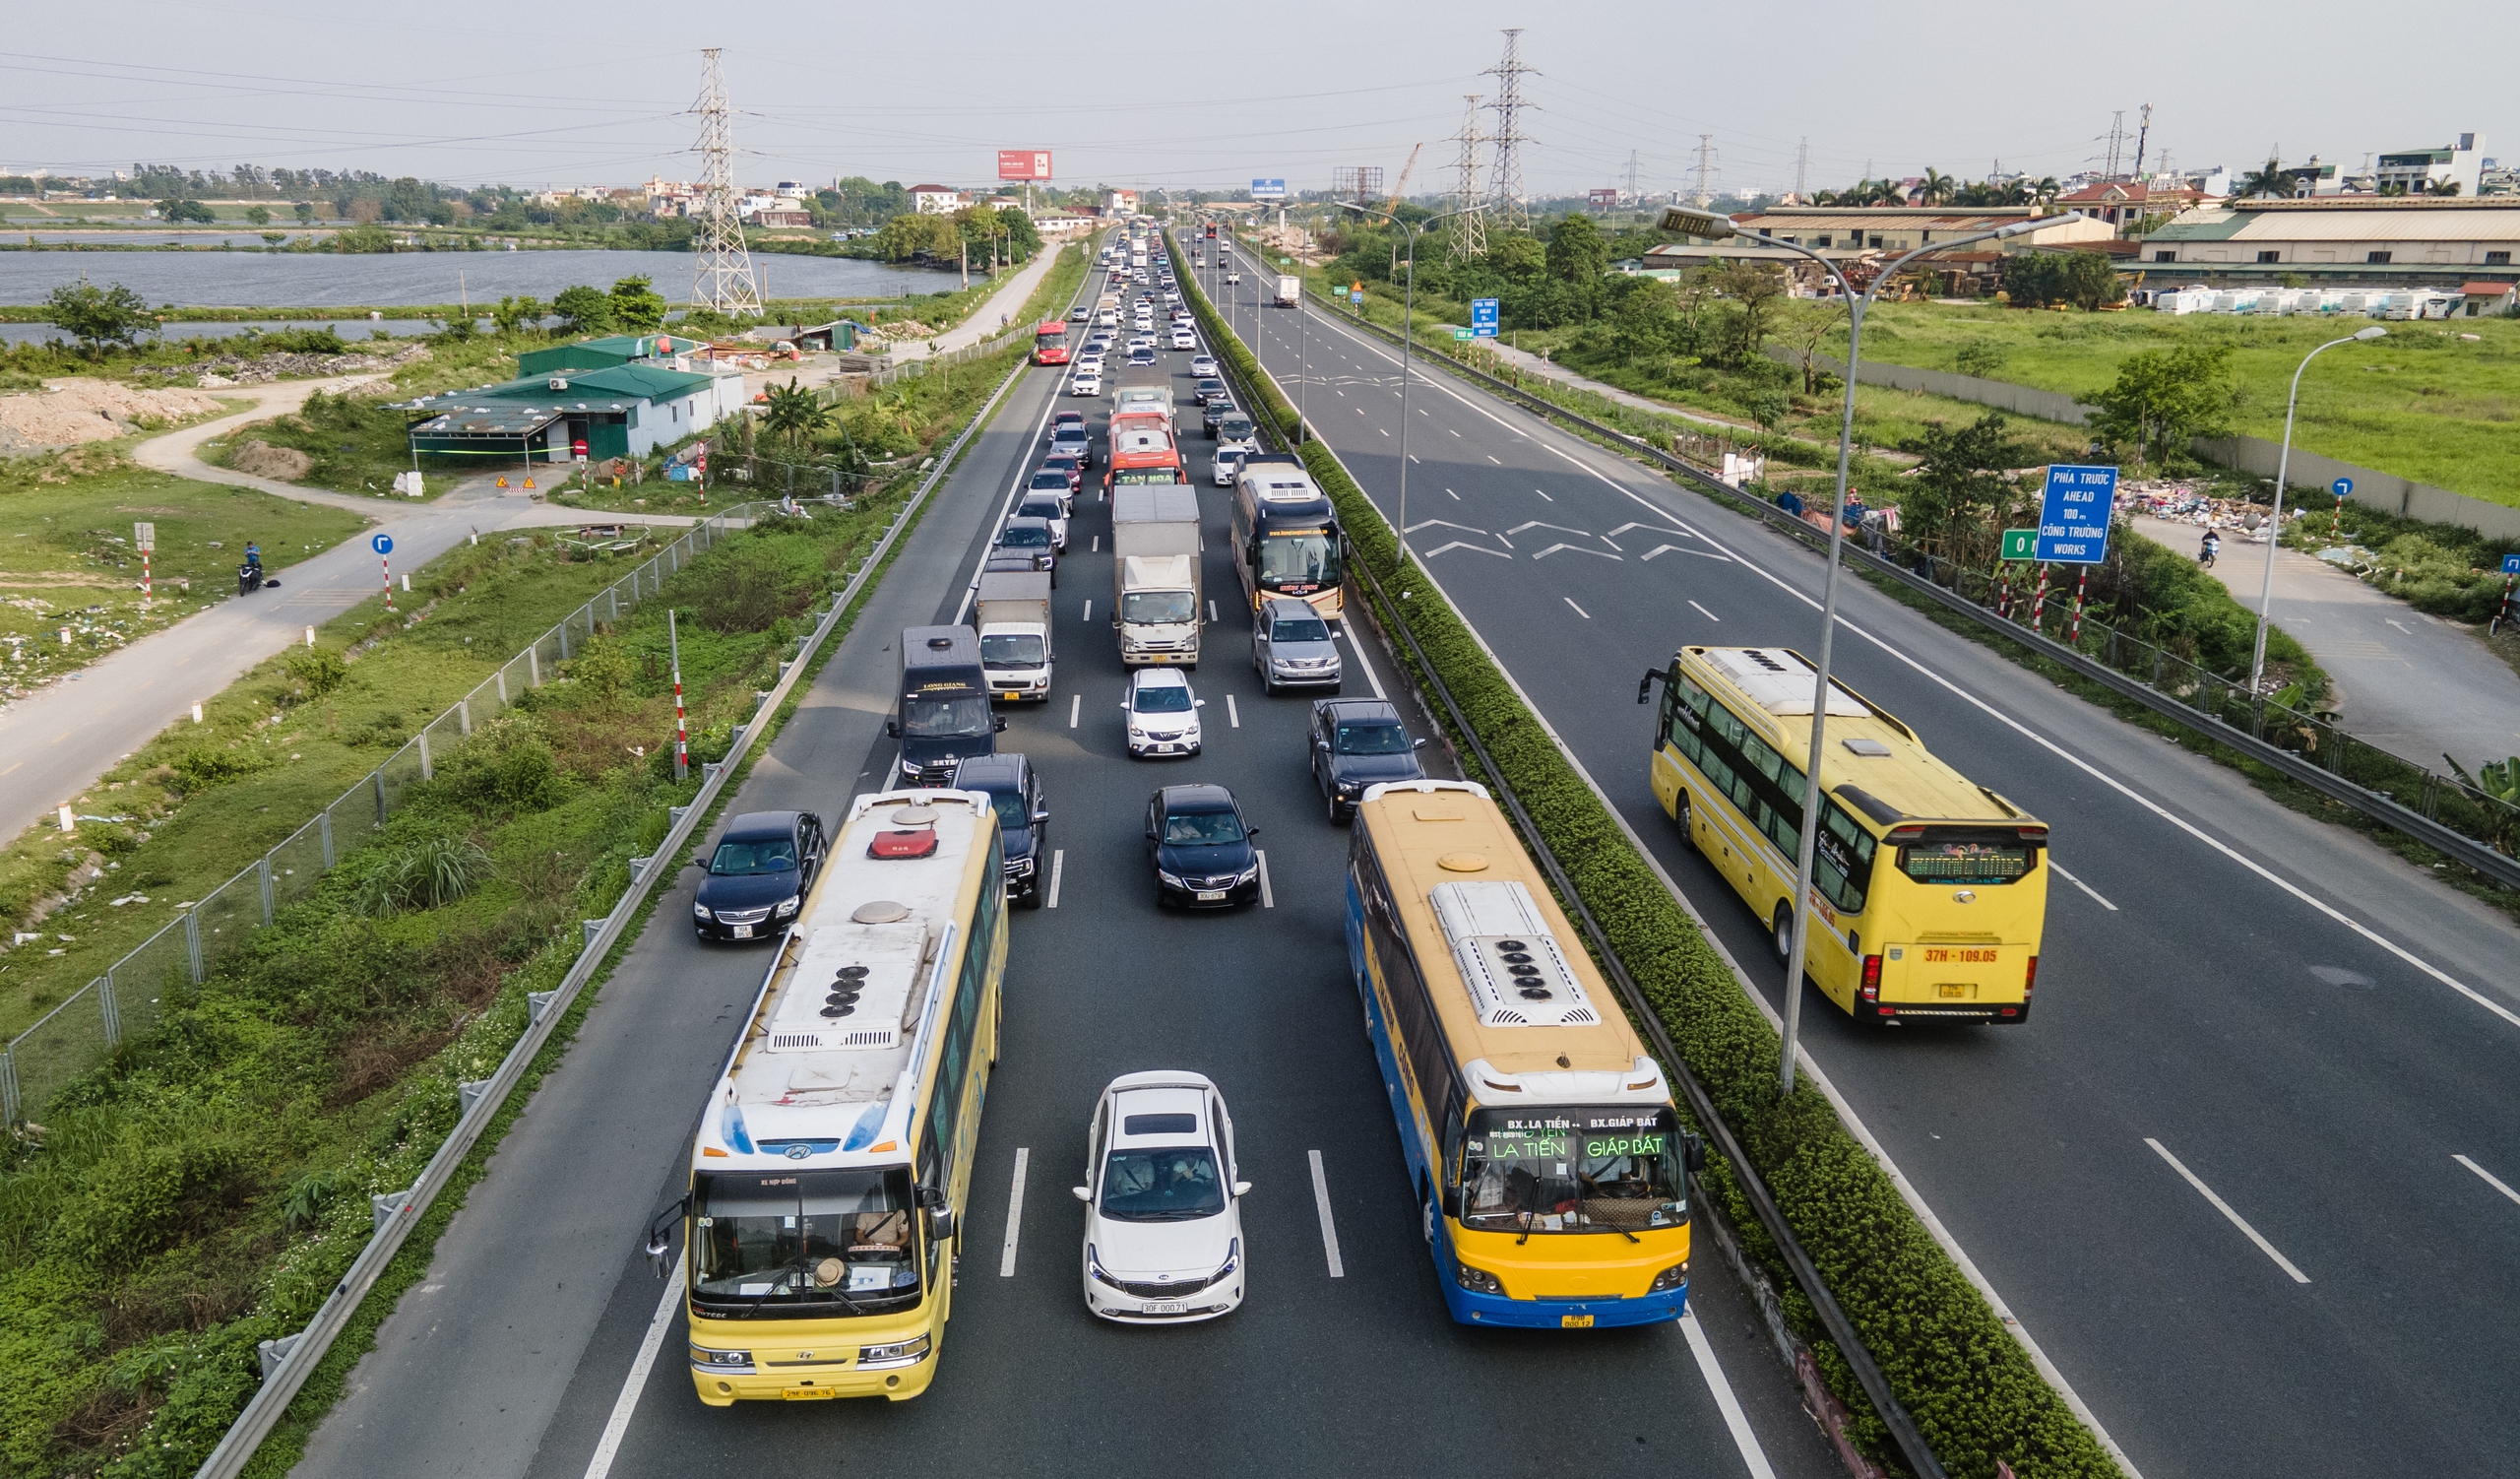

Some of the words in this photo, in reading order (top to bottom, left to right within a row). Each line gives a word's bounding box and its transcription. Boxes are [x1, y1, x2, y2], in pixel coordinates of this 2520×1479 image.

[2053, 470, 2075, 483] PHÍA
[2081, 471, 2110, 485] TRƯỚC
[2063, 490, 2094, 502] AHEAD
[2063, 508, 2078, 520] 100
[2042, 523, 2065, 537] CÔNG
[2069, 524, 2104, 539] TRƯỜNG
[2053, 544, 2086, 555] WORKS
[1925, 949, 1948, 962] 37H
[1960, 950, 1996, 962] 109.05
[1636, 1116, 1658, 1127] BÁT
[1493, 1142, 1520, 1158] LA
[1523, 1137, 1566, 1157] TIẾN
[1587, 1136, 1629, 1157] GIÁP
[1632, 1134, 1663, 1155] BÁT
